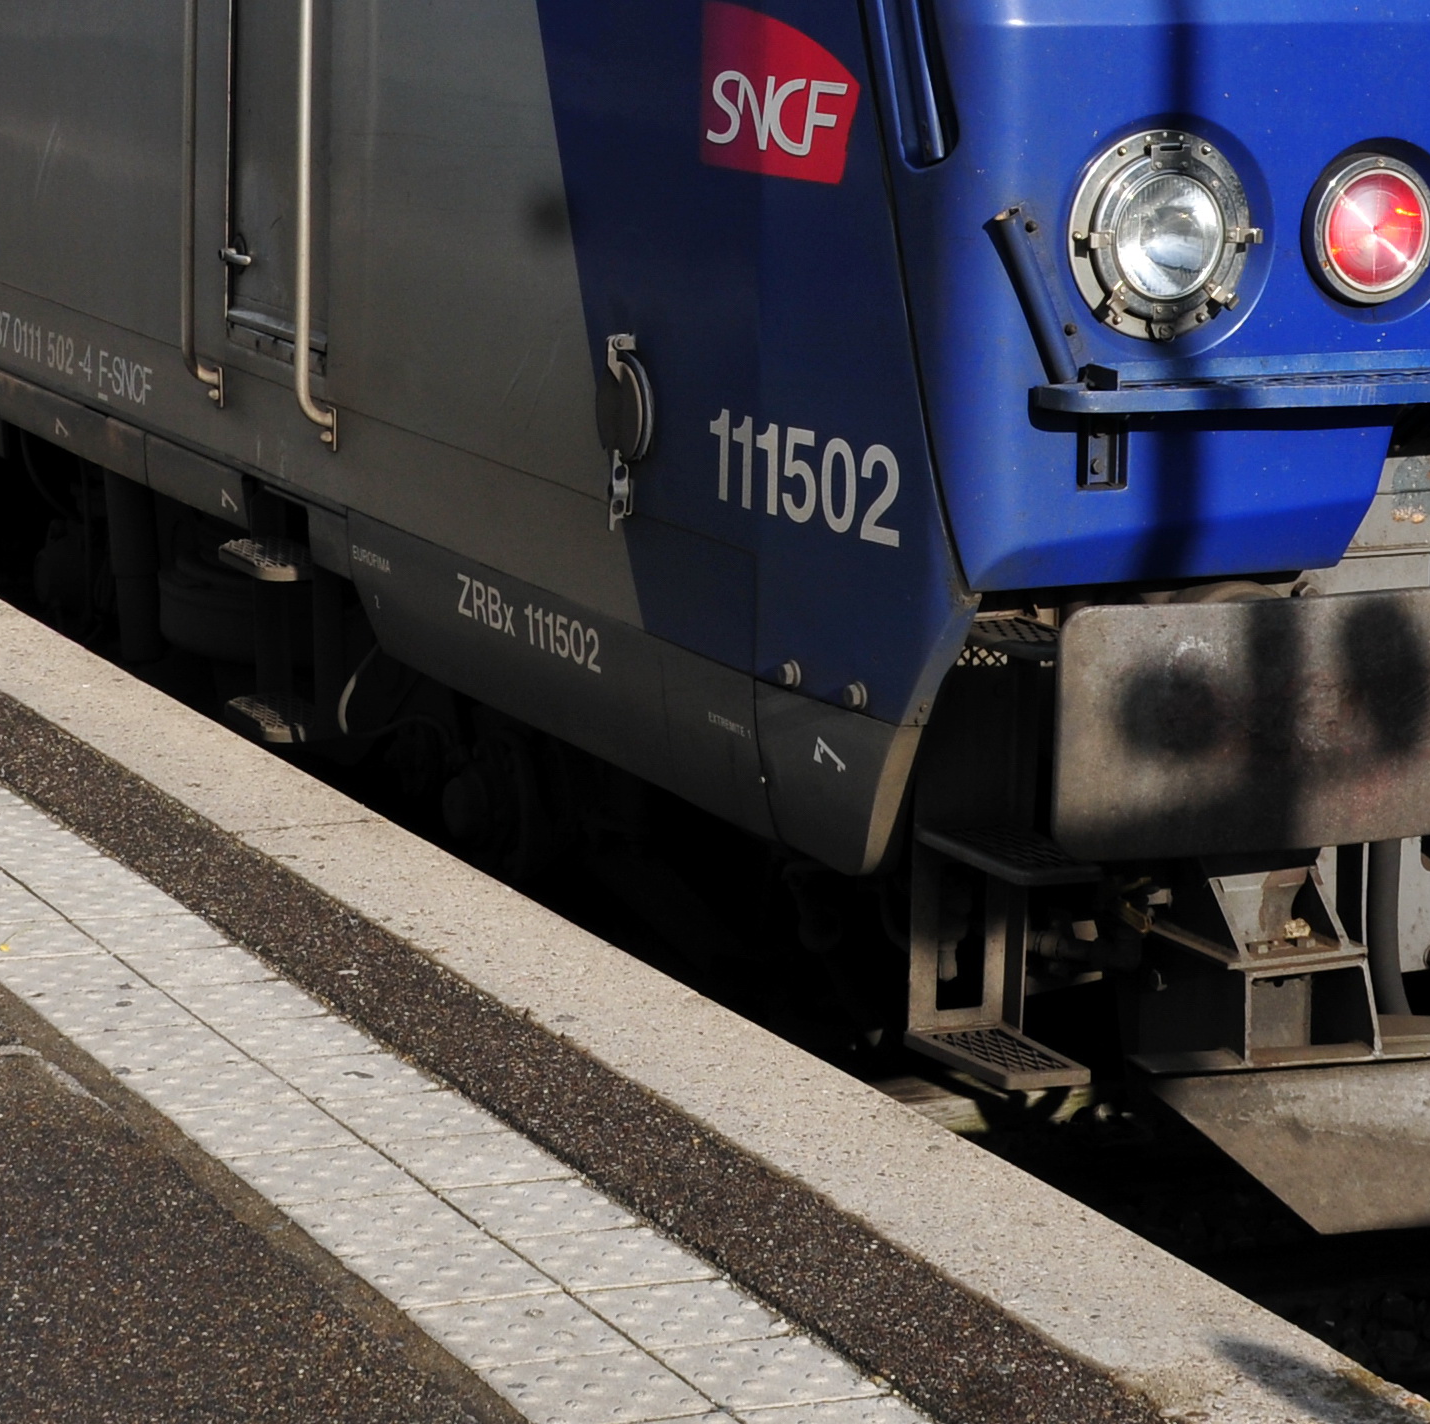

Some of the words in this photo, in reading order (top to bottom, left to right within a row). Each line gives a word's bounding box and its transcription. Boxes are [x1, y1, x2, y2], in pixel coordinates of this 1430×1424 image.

[706, 70, 848, 156] SNCF
[13, 317, 41, 363] 0111
[47, 331, 75, 375] 502
[709, 408, 900, 548] 111502
[352, 544, 391, 574] EUROFIMA
[457, 572, 516, 638] ZRBx
[524, 603, 602, 673] 111502
